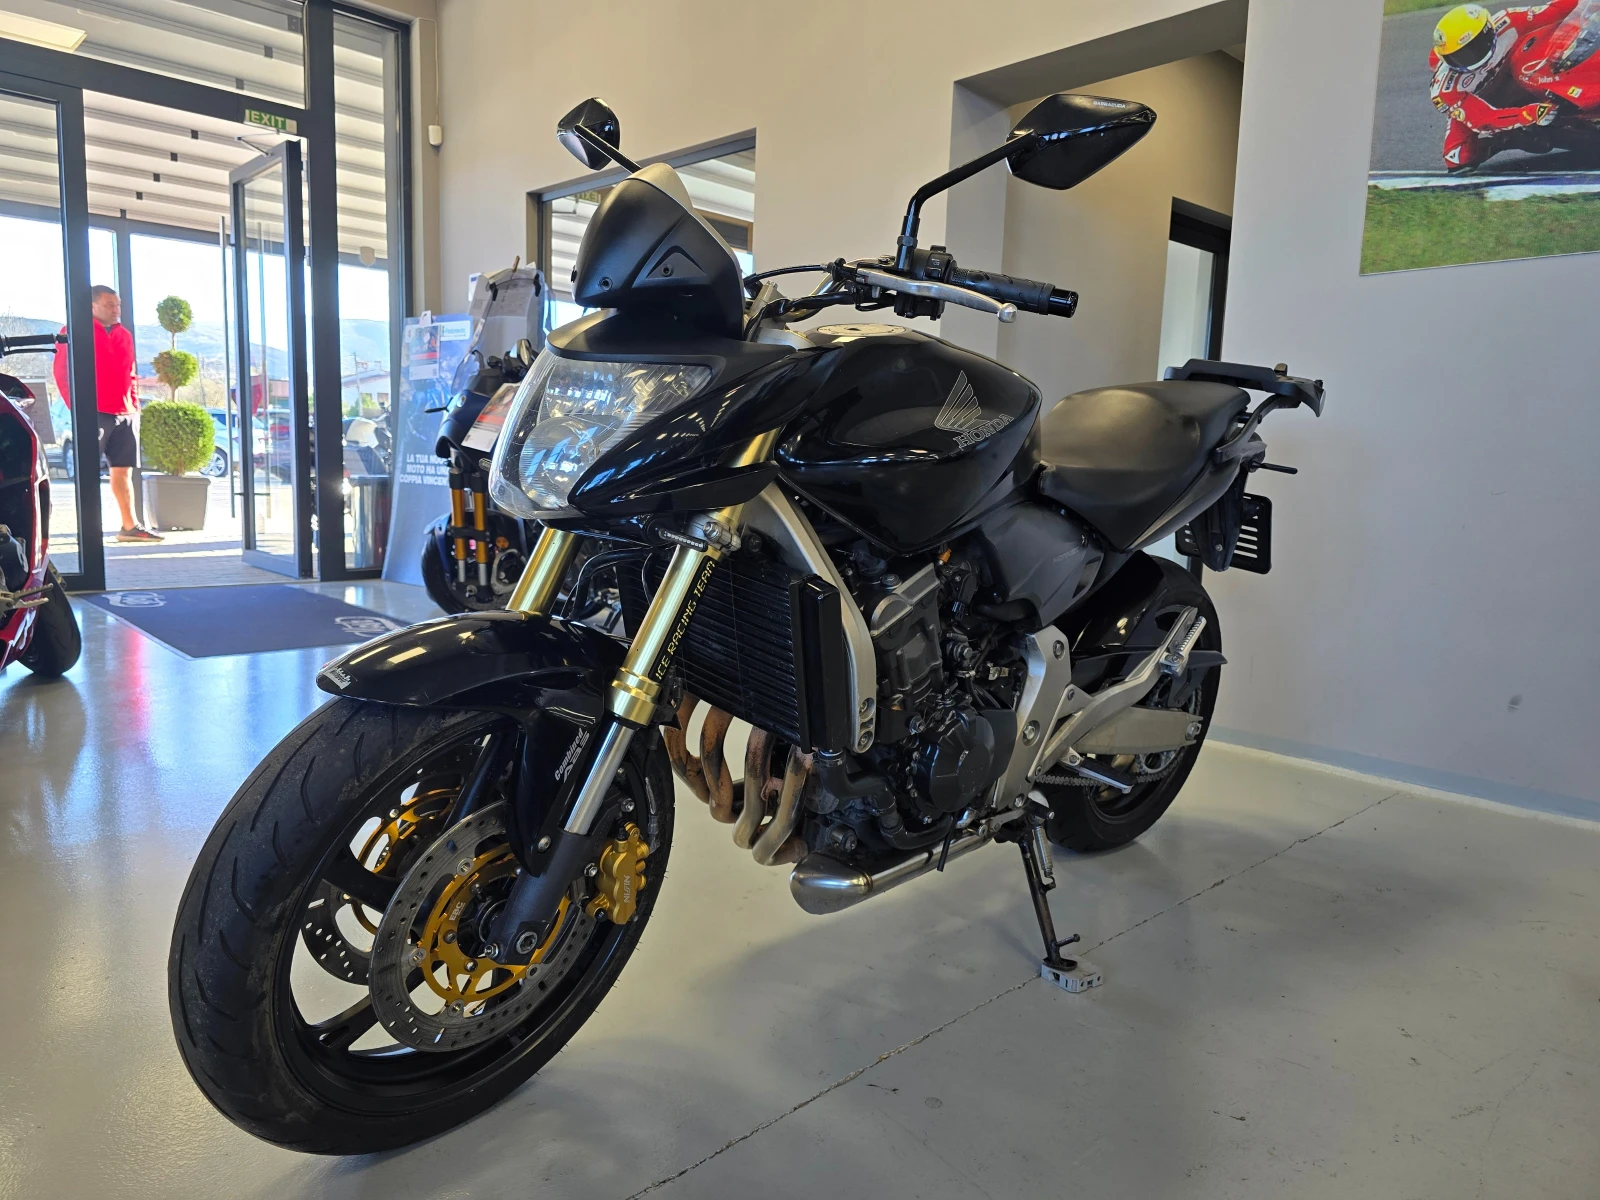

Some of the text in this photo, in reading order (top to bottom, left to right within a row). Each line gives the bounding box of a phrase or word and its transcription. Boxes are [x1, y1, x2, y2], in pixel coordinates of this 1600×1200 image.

[251, 110, 285, 129] EXIT
[953, 413, 1015, 451] HONDA
[406, 453, 415, 463] LA
[415, 454, 429, 464] TUA
[400, 473, 423, 485] COPPIA
[406, 464, 425, 473] MOTO
[426, 465, 436, 475] HA
[655, 560, 716, 680] ICE RACING TEAM
[554, 727, 584, 781] Combined
[448, 901, 464, 921] EBC
